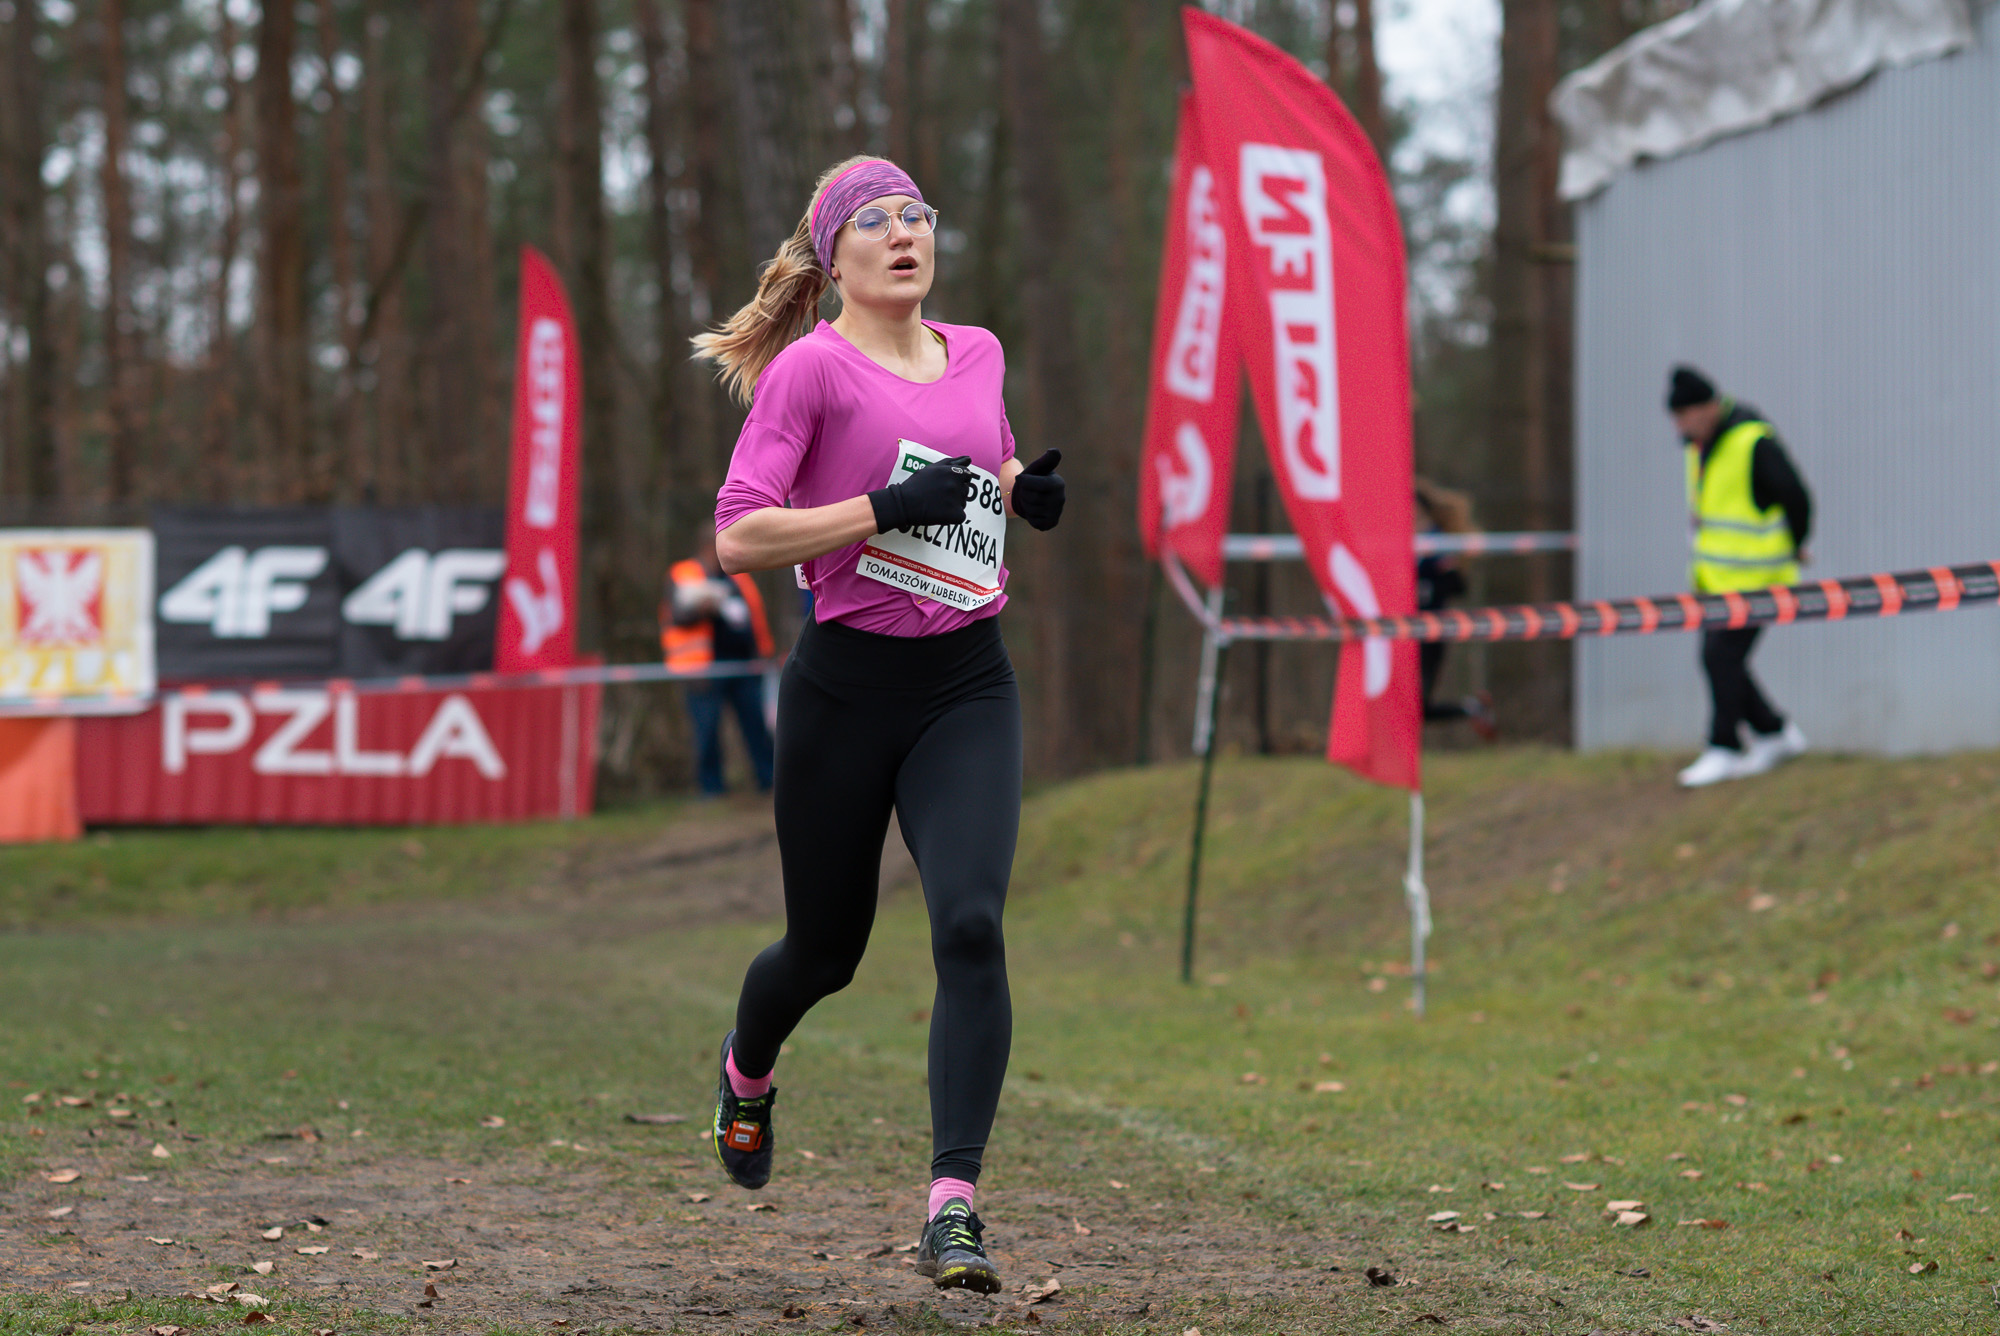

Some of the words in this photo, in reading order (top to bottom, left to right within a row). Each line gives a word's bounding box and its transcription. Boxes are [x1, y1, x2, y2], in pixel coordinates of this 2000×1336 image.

[158, 545, 329, 639] 4F
[342, 547, 507, 641] 4F
[865, 560, 931, 594] TOMASZÓW
[930, 583, 971, 607] LUBELSKI
[161, 688, 506, 780] PZLA
